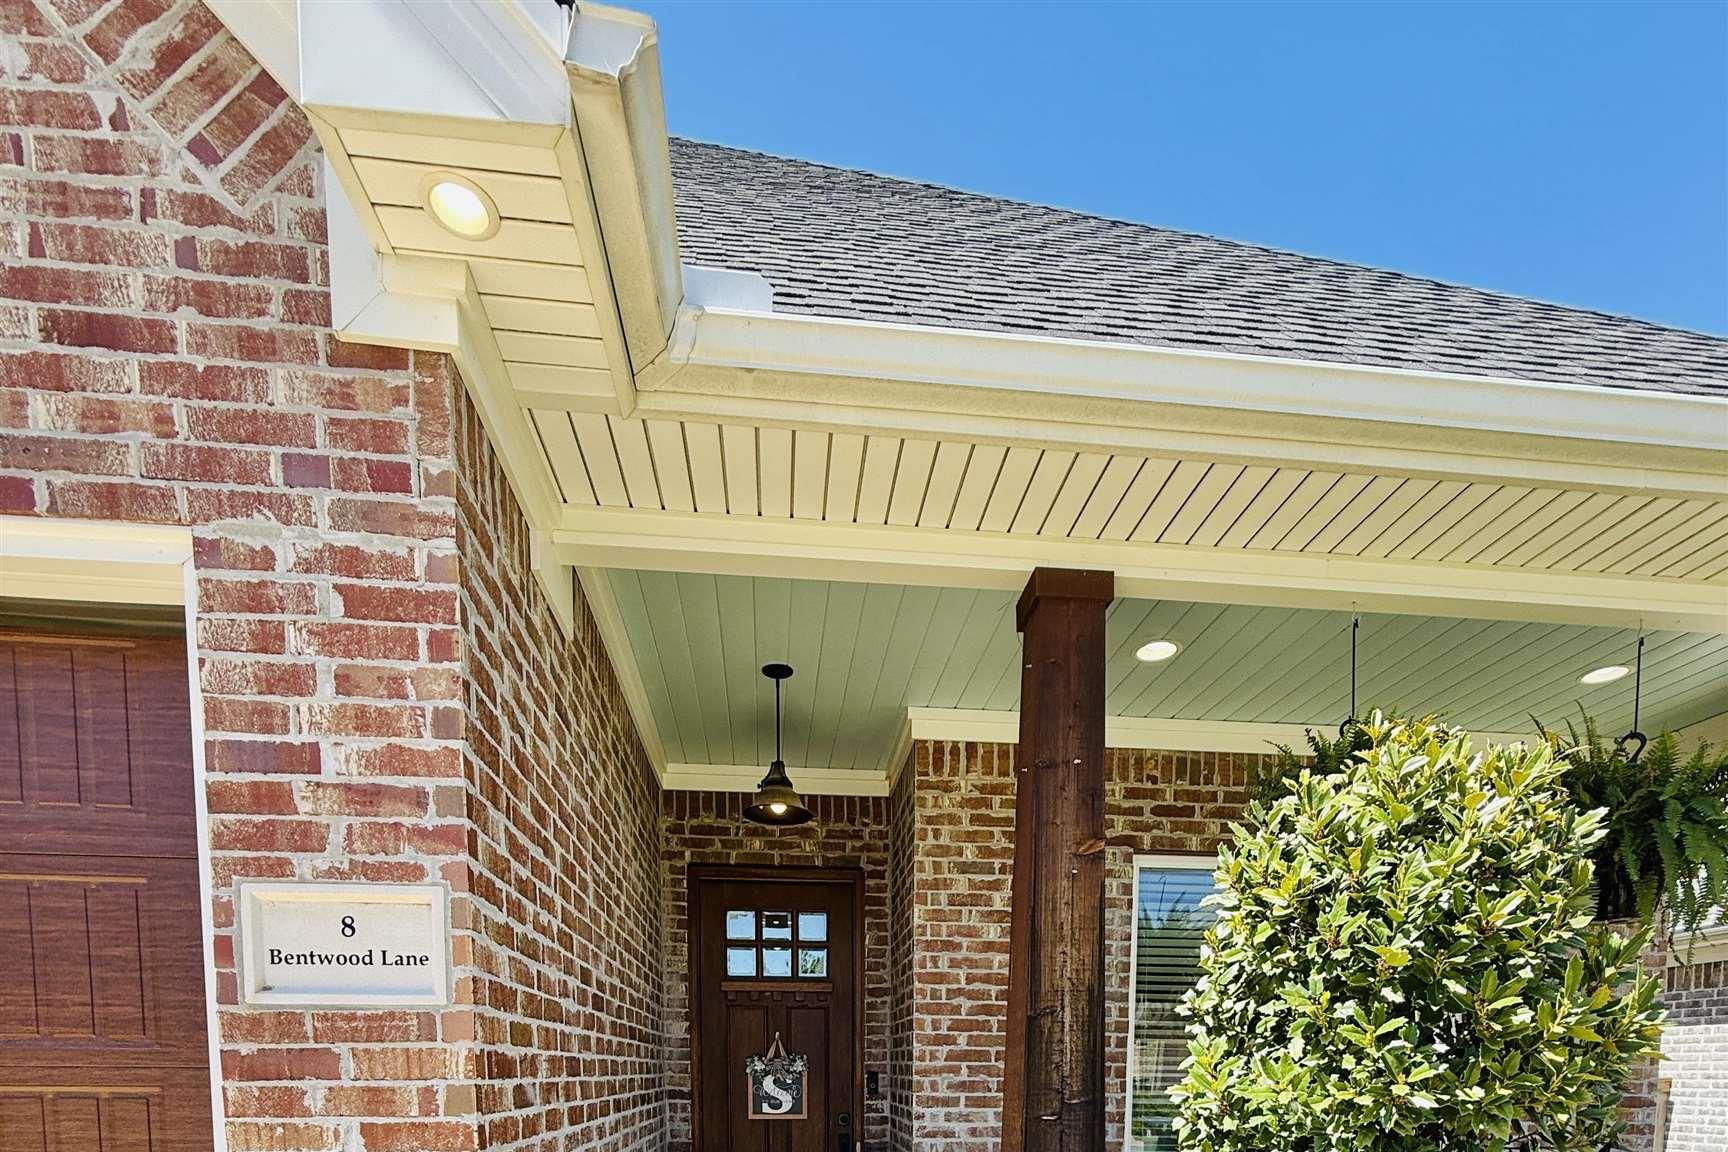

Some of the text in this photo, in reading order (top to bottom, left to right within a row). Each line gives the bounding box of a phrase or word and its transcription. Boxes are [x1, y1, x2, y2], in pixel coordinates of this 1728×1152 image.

[341, 915, 356, 937] 8
[269, 948, 430, 966] Bentwood Lane
[762, 1074, 793, 1114] S
